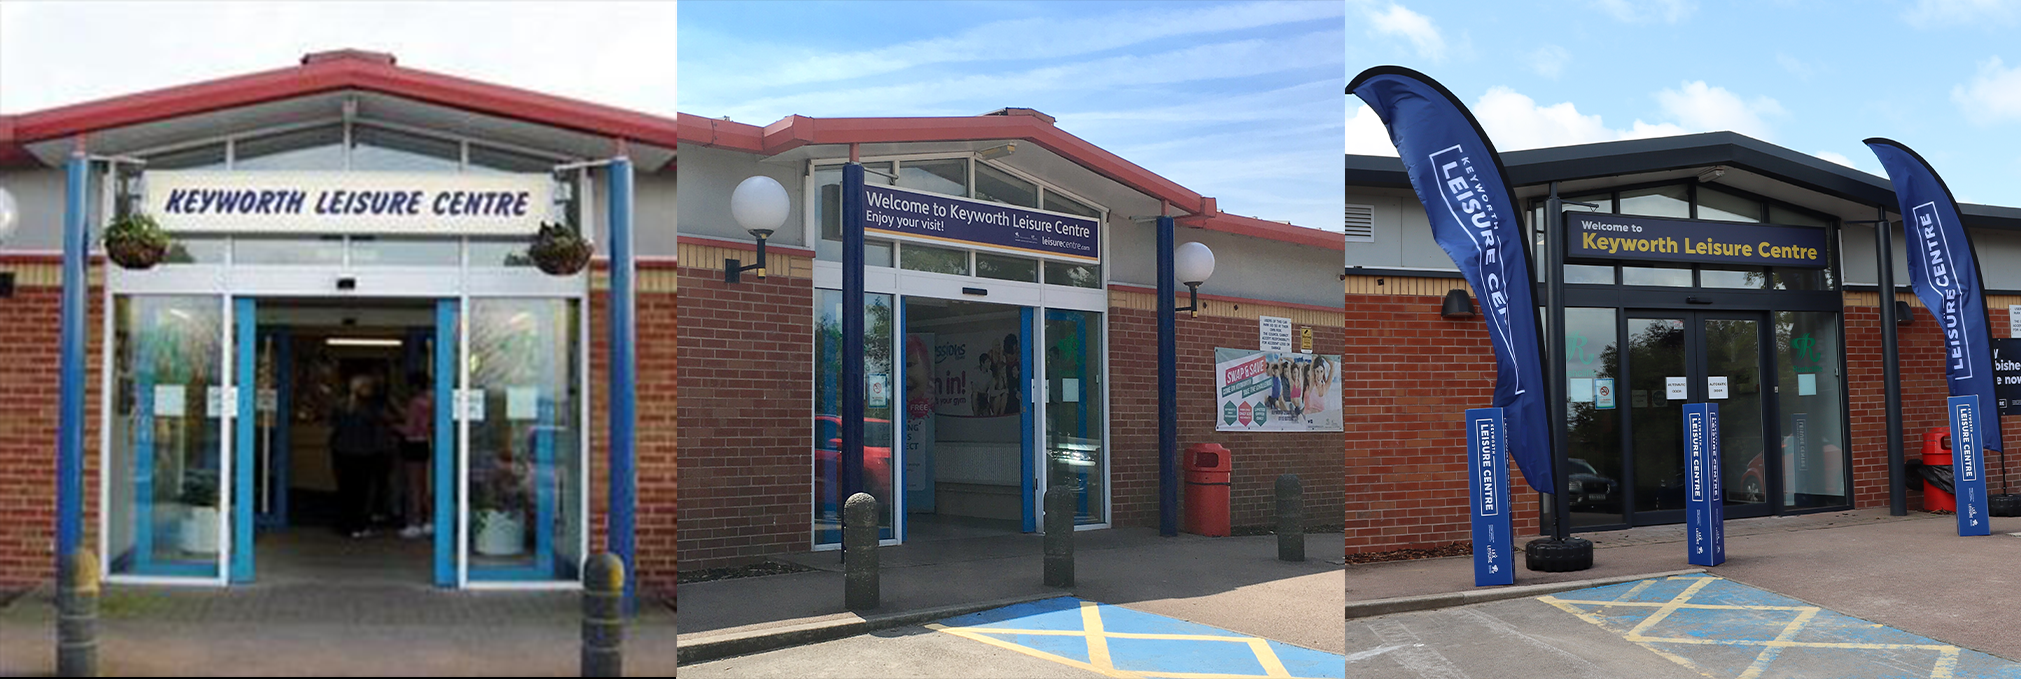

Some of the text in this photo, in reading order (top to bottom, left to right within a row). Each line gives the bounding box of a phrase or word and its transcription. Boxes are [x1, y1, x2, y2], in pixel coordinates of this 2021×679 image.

[165, 189, 530, 216] KEYWORTH LEISURE CENTRE
[1461, 156, 1499, 230] KEYWORTH
[866, 191, 1090, 238] Welcome to Keyworth Leisure Centre
[866, 210, 944, 231] Enjoy your visit!
[1442, 161, 1496, 265] LEISURE
[1581, 220, 1643, 233] Welcome to
[1042, 236, 1091, 251] leisurecentre.com
[1582, 232, 1818, 260] Keyworth Leisure Centre
[1919, 213, 1964, 370] LEISURE CENTRE
[1226, 368, 1244, 384] SWAP
[1249, 360, 1265, 375] SAVE
[910, 403, 928, 411] FREE
[1691, 417, 1699, 457] LEISURE
[1960, 408, 1970, 443] LEISURE
[1480, 423, 1491, 467] LEISURE
[1963, 444, 1973, 477] CENTRE
[1483, 469, 1494, 511] CENTRE
